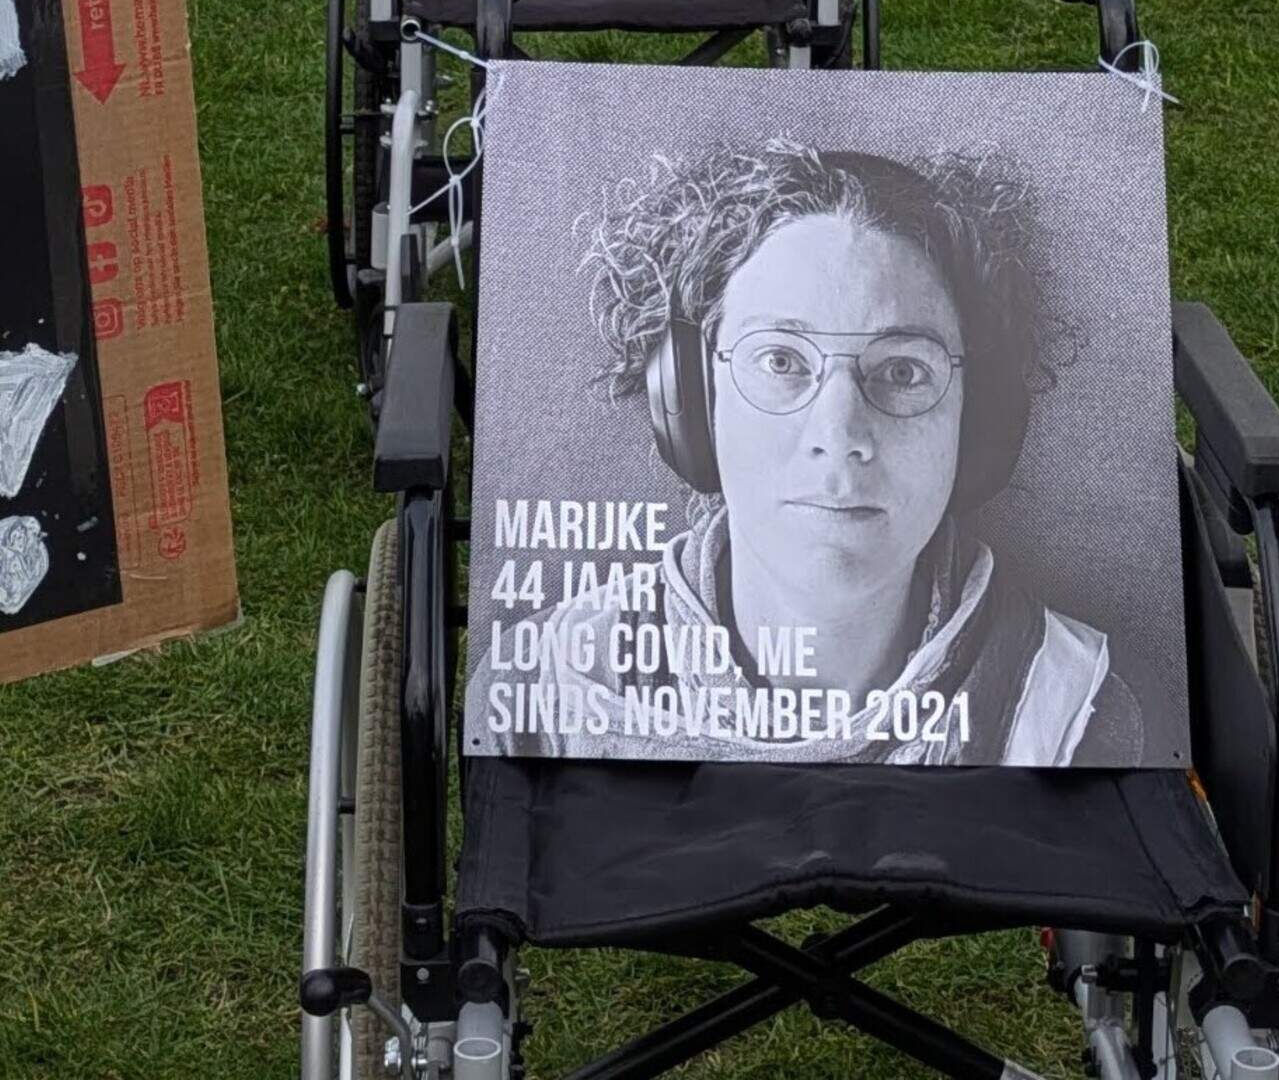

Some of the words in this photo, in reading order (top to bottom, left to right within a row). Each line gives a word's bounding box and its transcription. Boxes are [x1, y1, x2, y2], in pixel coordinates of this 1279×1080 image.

[128, 218, 141, 254] social
[494, 499, 669, 552] MARIJKE
[490, 561, 545, 610] 44
[556, 562, 658, 612] JAAR
[489, 622, 596, 673] LONG
[609, 624, 745, 682] COVID,
[758, 627, 818, 678] ME
[488, 682, 611, 736] SINDS
[624, 686, 854, 741] NOVEMBER
[864, 689, 972, 743] 2021
